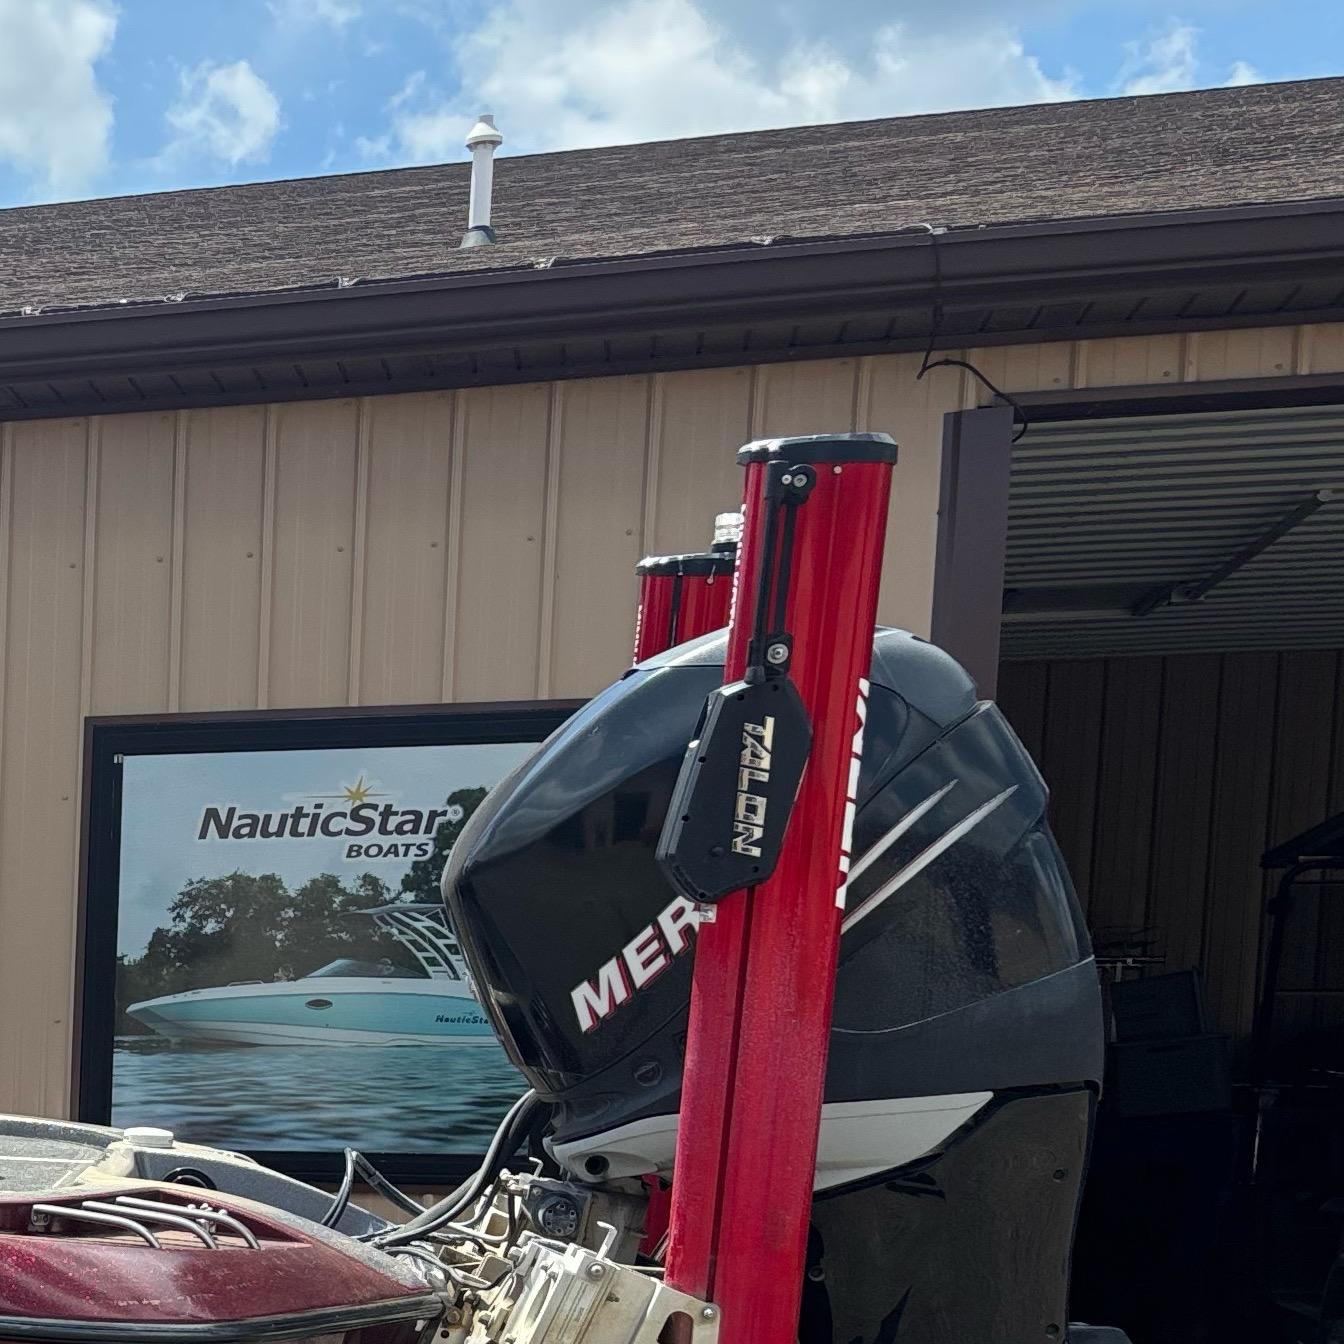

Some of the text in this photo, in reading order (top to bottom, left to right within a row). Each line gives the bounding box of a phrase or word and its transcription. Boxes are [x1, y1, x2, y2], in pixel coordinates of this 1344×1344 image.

[731, 715, 776, 858] TALON
[198, 803, 449, 840] NauticStar
[345, 842, 430, 859] BOATS
